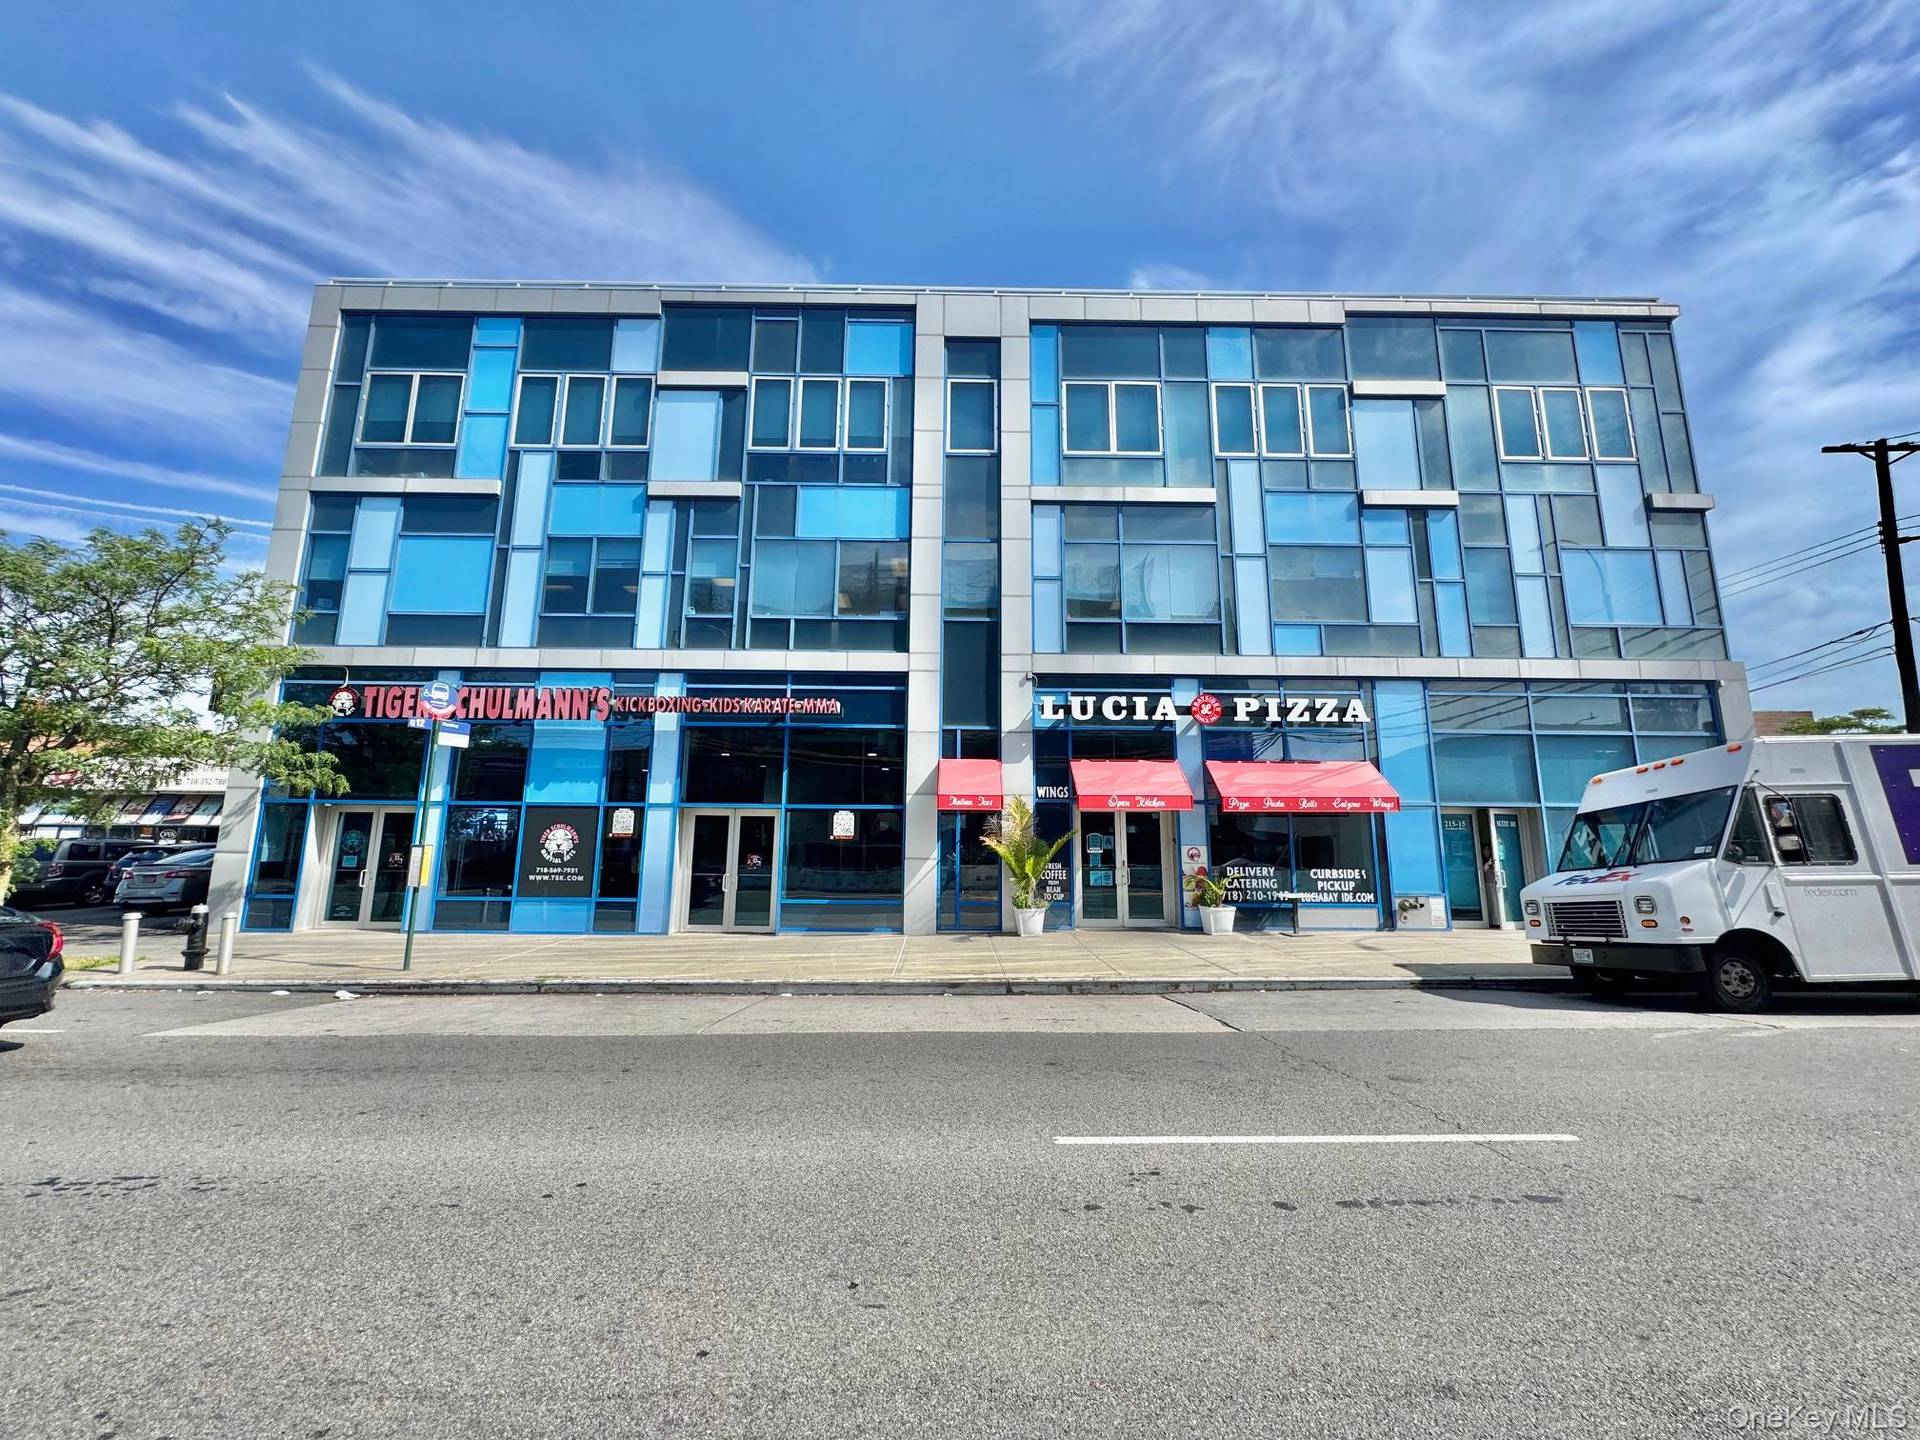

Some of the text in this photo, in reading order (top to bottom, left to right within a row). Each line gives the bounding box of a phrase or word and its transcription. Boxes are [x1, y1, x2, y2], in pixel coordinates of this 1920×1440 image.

[455, 686, 612, 721] CHULMANN'S
[615, 696, 838, 715] KICKBOXING KIDS KARATE MMA
[1040, 695, 1180, 721] LUCIA
[1233, 697, 1371, 723] PIZZA
[1037, 786, 1069, 798] WINGS
[1107, 795, 1166, 809] Open Kitchen
[1228, 797, 1250, 810] Pizza
[1263, 797, 1285, 809] Pasta
[1298, 797, 1318, 809] Rolls
[1368, 797, 1394, 810] Wings
[1040, 870, 1067, 880] COFFEE
[1226, 866, 1276, 877] DELIVERY
[1310, 869, 1360, 879] CURBSIDE
[1225, 879, 1278, 889] CATERING
[1552, 871, 1638, 887] FedEx
[1317, 880, 1356, 891] PICKUP
[1053, 893, 1065, 901] CUP
